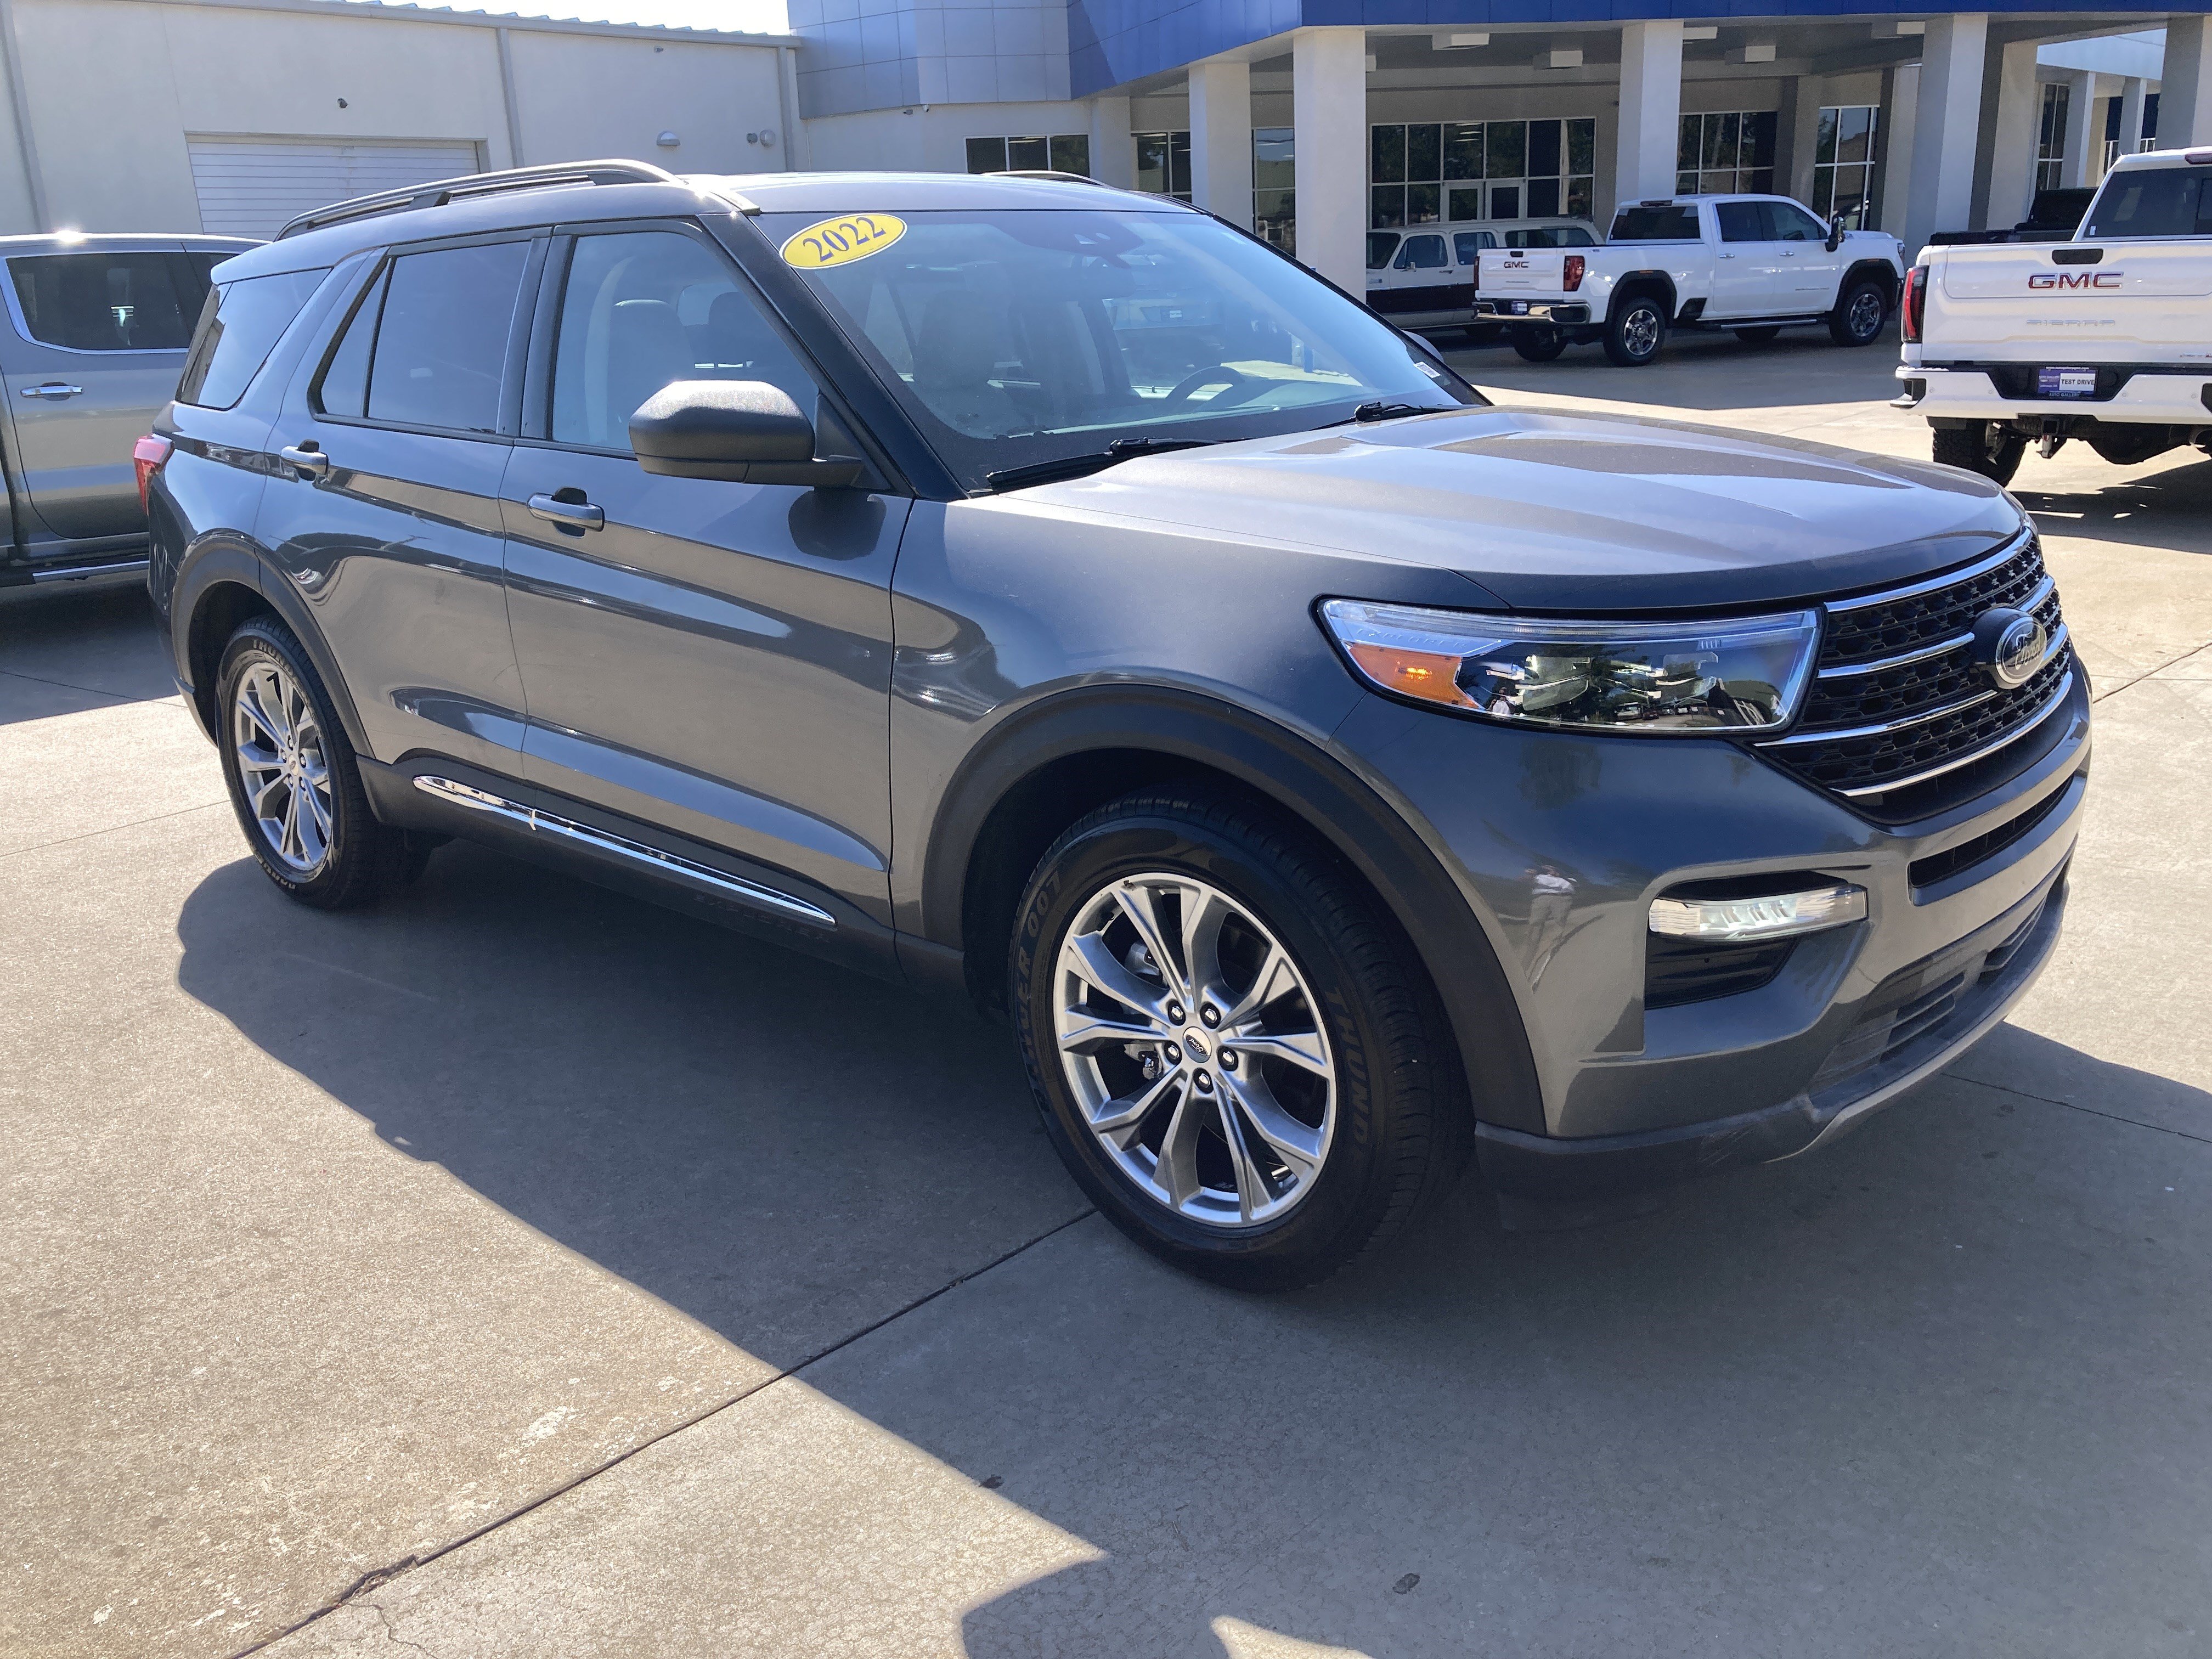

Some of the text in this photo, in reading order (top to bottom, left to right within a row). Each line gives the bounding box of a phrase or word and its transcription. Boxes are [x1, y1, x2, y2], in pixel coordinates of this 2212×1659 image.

[803, 217, 887, 262] 2022
[2028, 271, 2124, 290] GMC
[1027, 870, 1060, 939] 007
[1189, 1038, 1204, 1053] Ford
